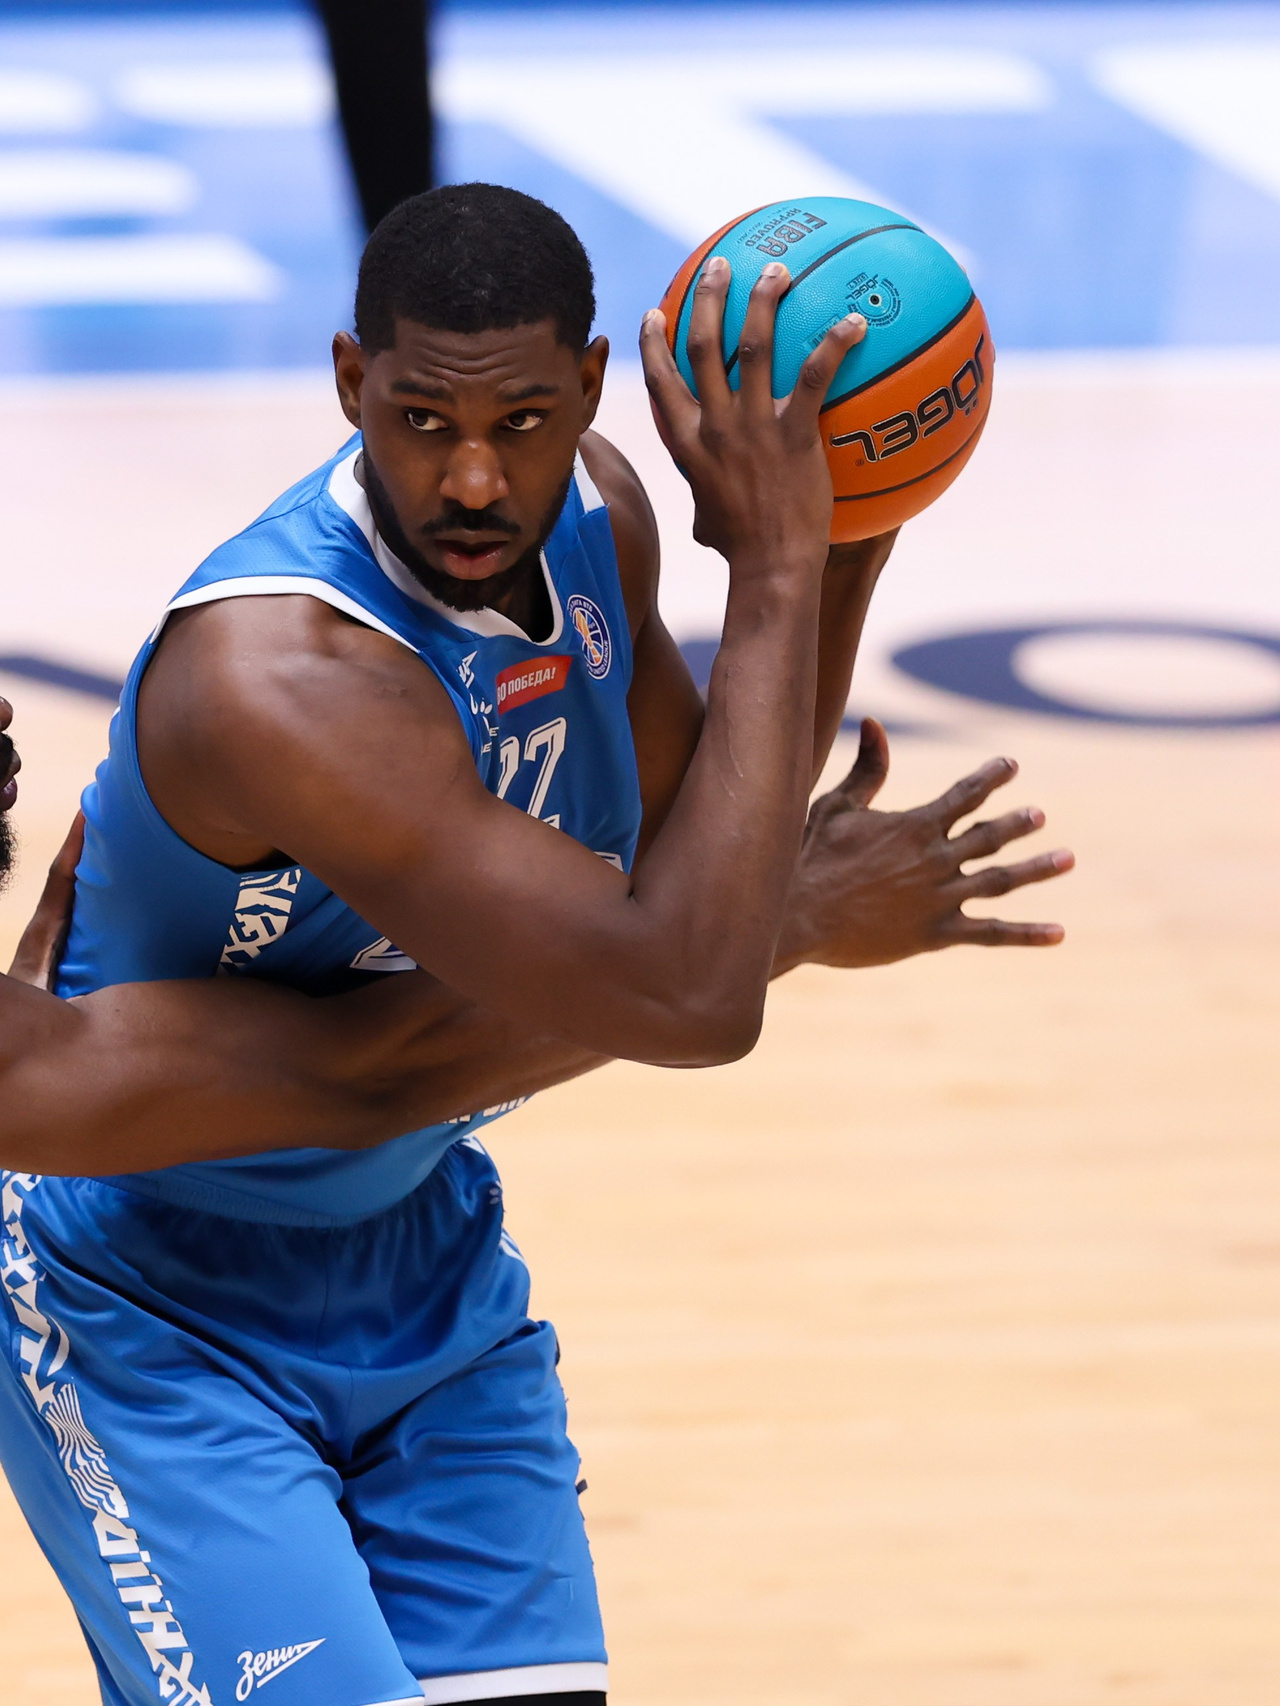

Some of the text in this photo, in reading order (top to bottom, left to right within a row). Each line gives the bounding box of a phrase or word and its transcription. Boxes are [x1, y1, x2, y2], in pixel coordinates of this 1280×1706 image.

[745, 207, 801, 247] APPROVED
[756, 212, 828, 257] FIBA
[845, 274, 879, 301] JÖGEL
[830, 333, 985, 463] JÖGEL
[508, 667, 556, 695] ПОБЕДА!
